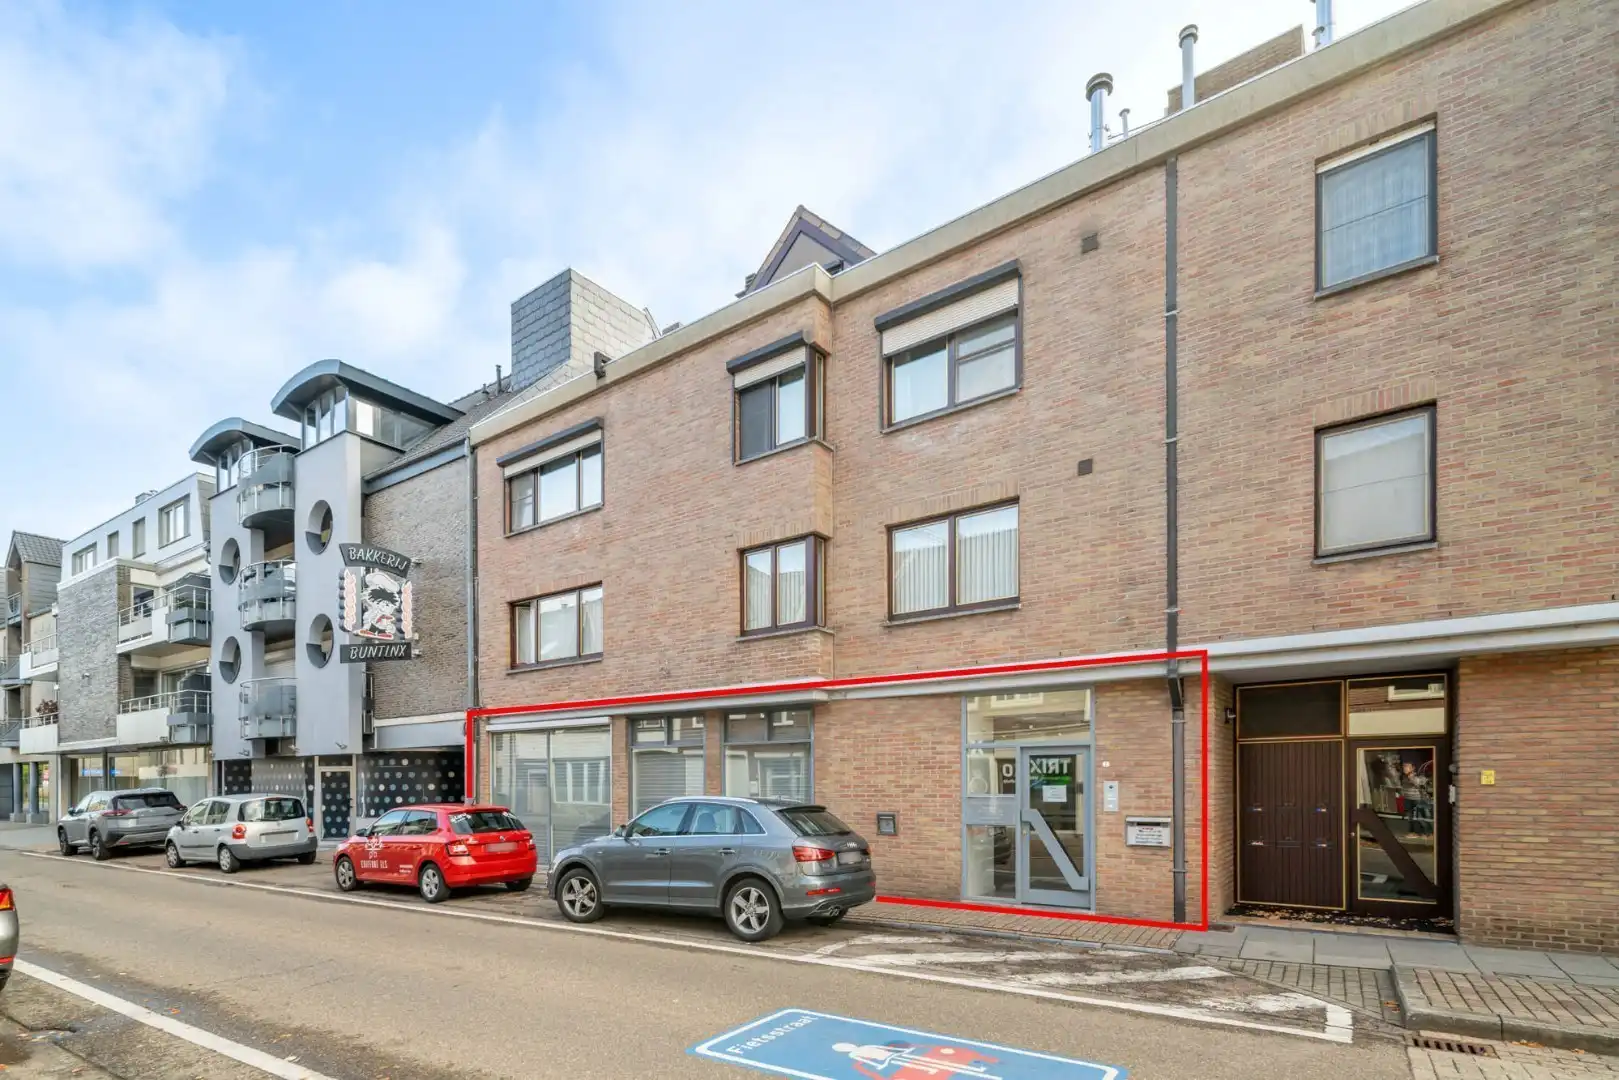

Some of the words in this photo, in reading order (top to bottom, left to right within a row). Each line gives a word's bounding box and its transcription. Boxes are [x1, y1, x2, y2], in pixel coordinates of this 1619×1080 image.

[348, 546, 408, 570] BAKKERIJ
[349, 645, 407, 660] BUNTINX
[726, 1015, 819, 1055] Fietsstraat
